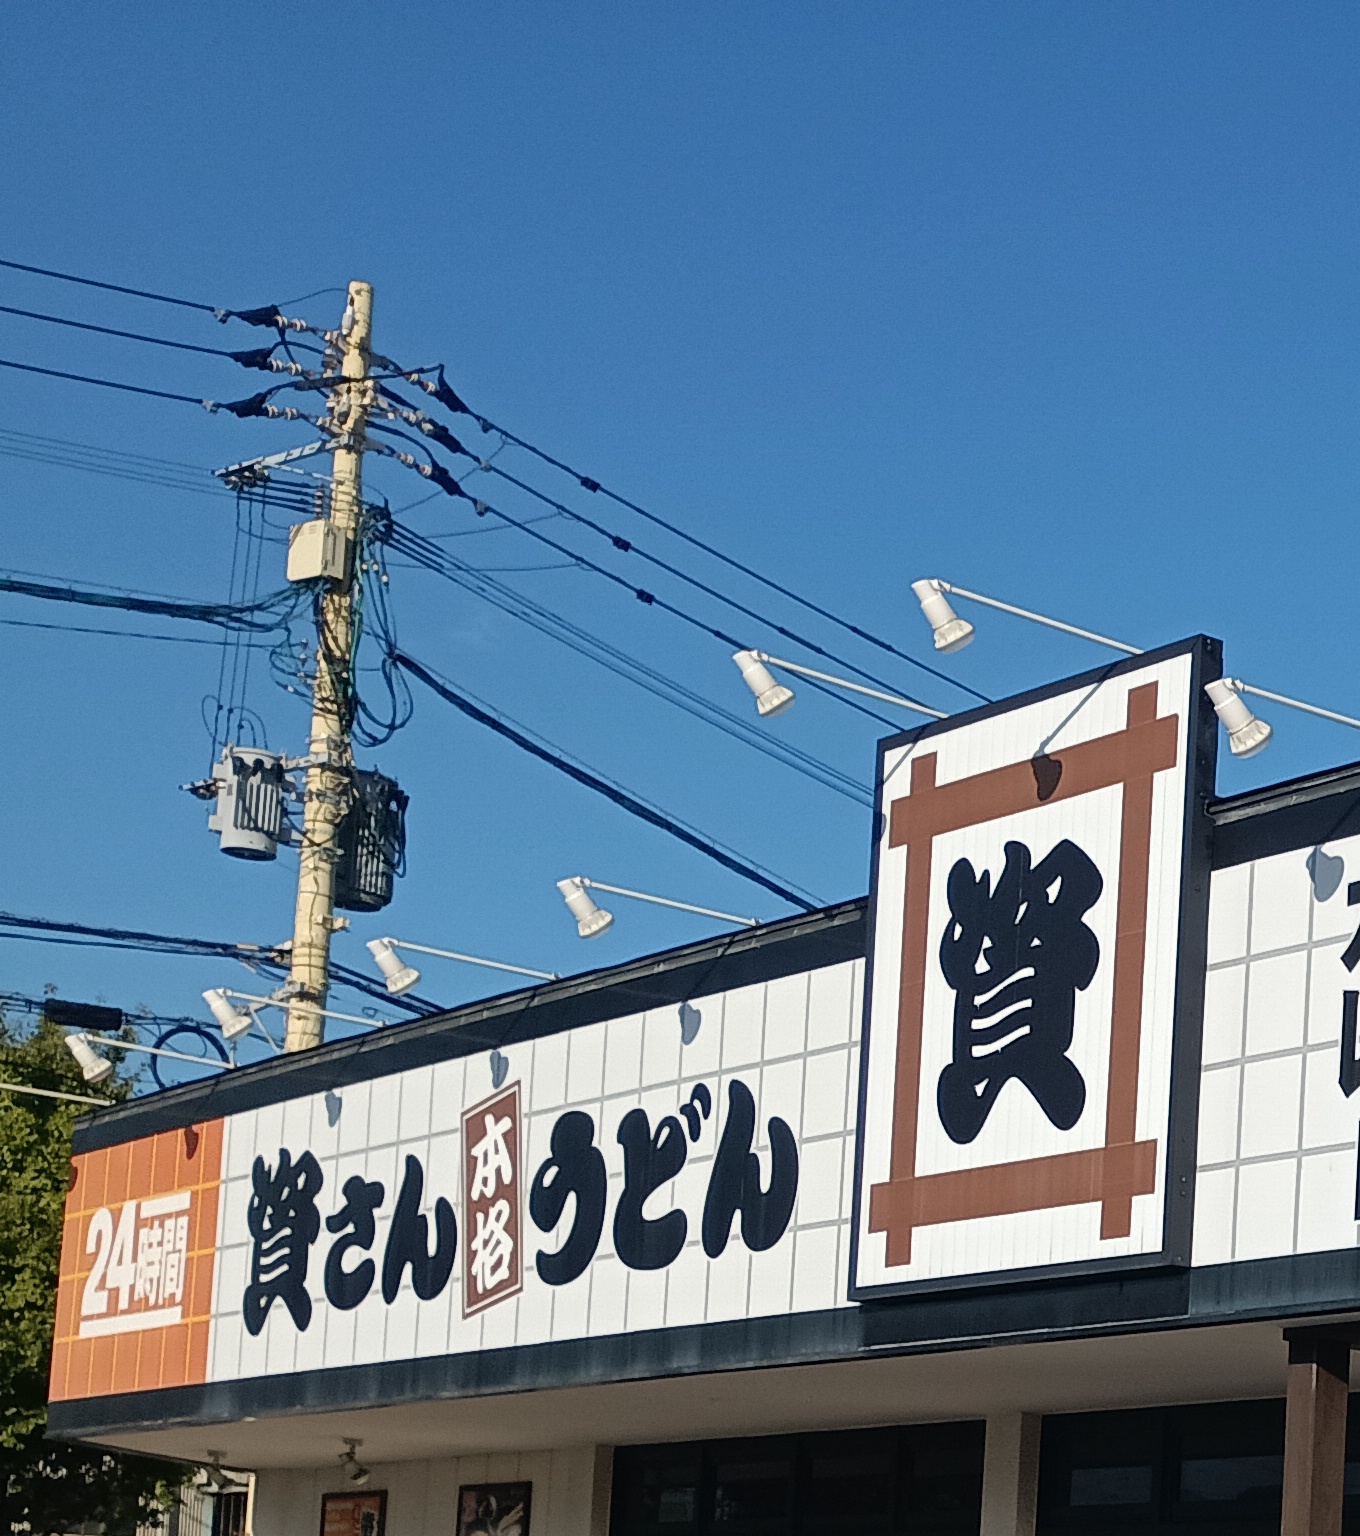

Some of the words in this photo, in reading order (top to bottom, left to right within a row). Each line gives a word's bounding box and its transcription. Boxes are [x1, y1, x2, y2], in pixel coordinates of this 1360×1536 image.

[936, 839, 1104, 1145] 資
[82, 1201, 189, 1316] 24時間
[243, 1147, 457, 1336] 資さん
[470, 1113, 512, 1295] 本格
[529, 1079, 799, 1286] うどん
